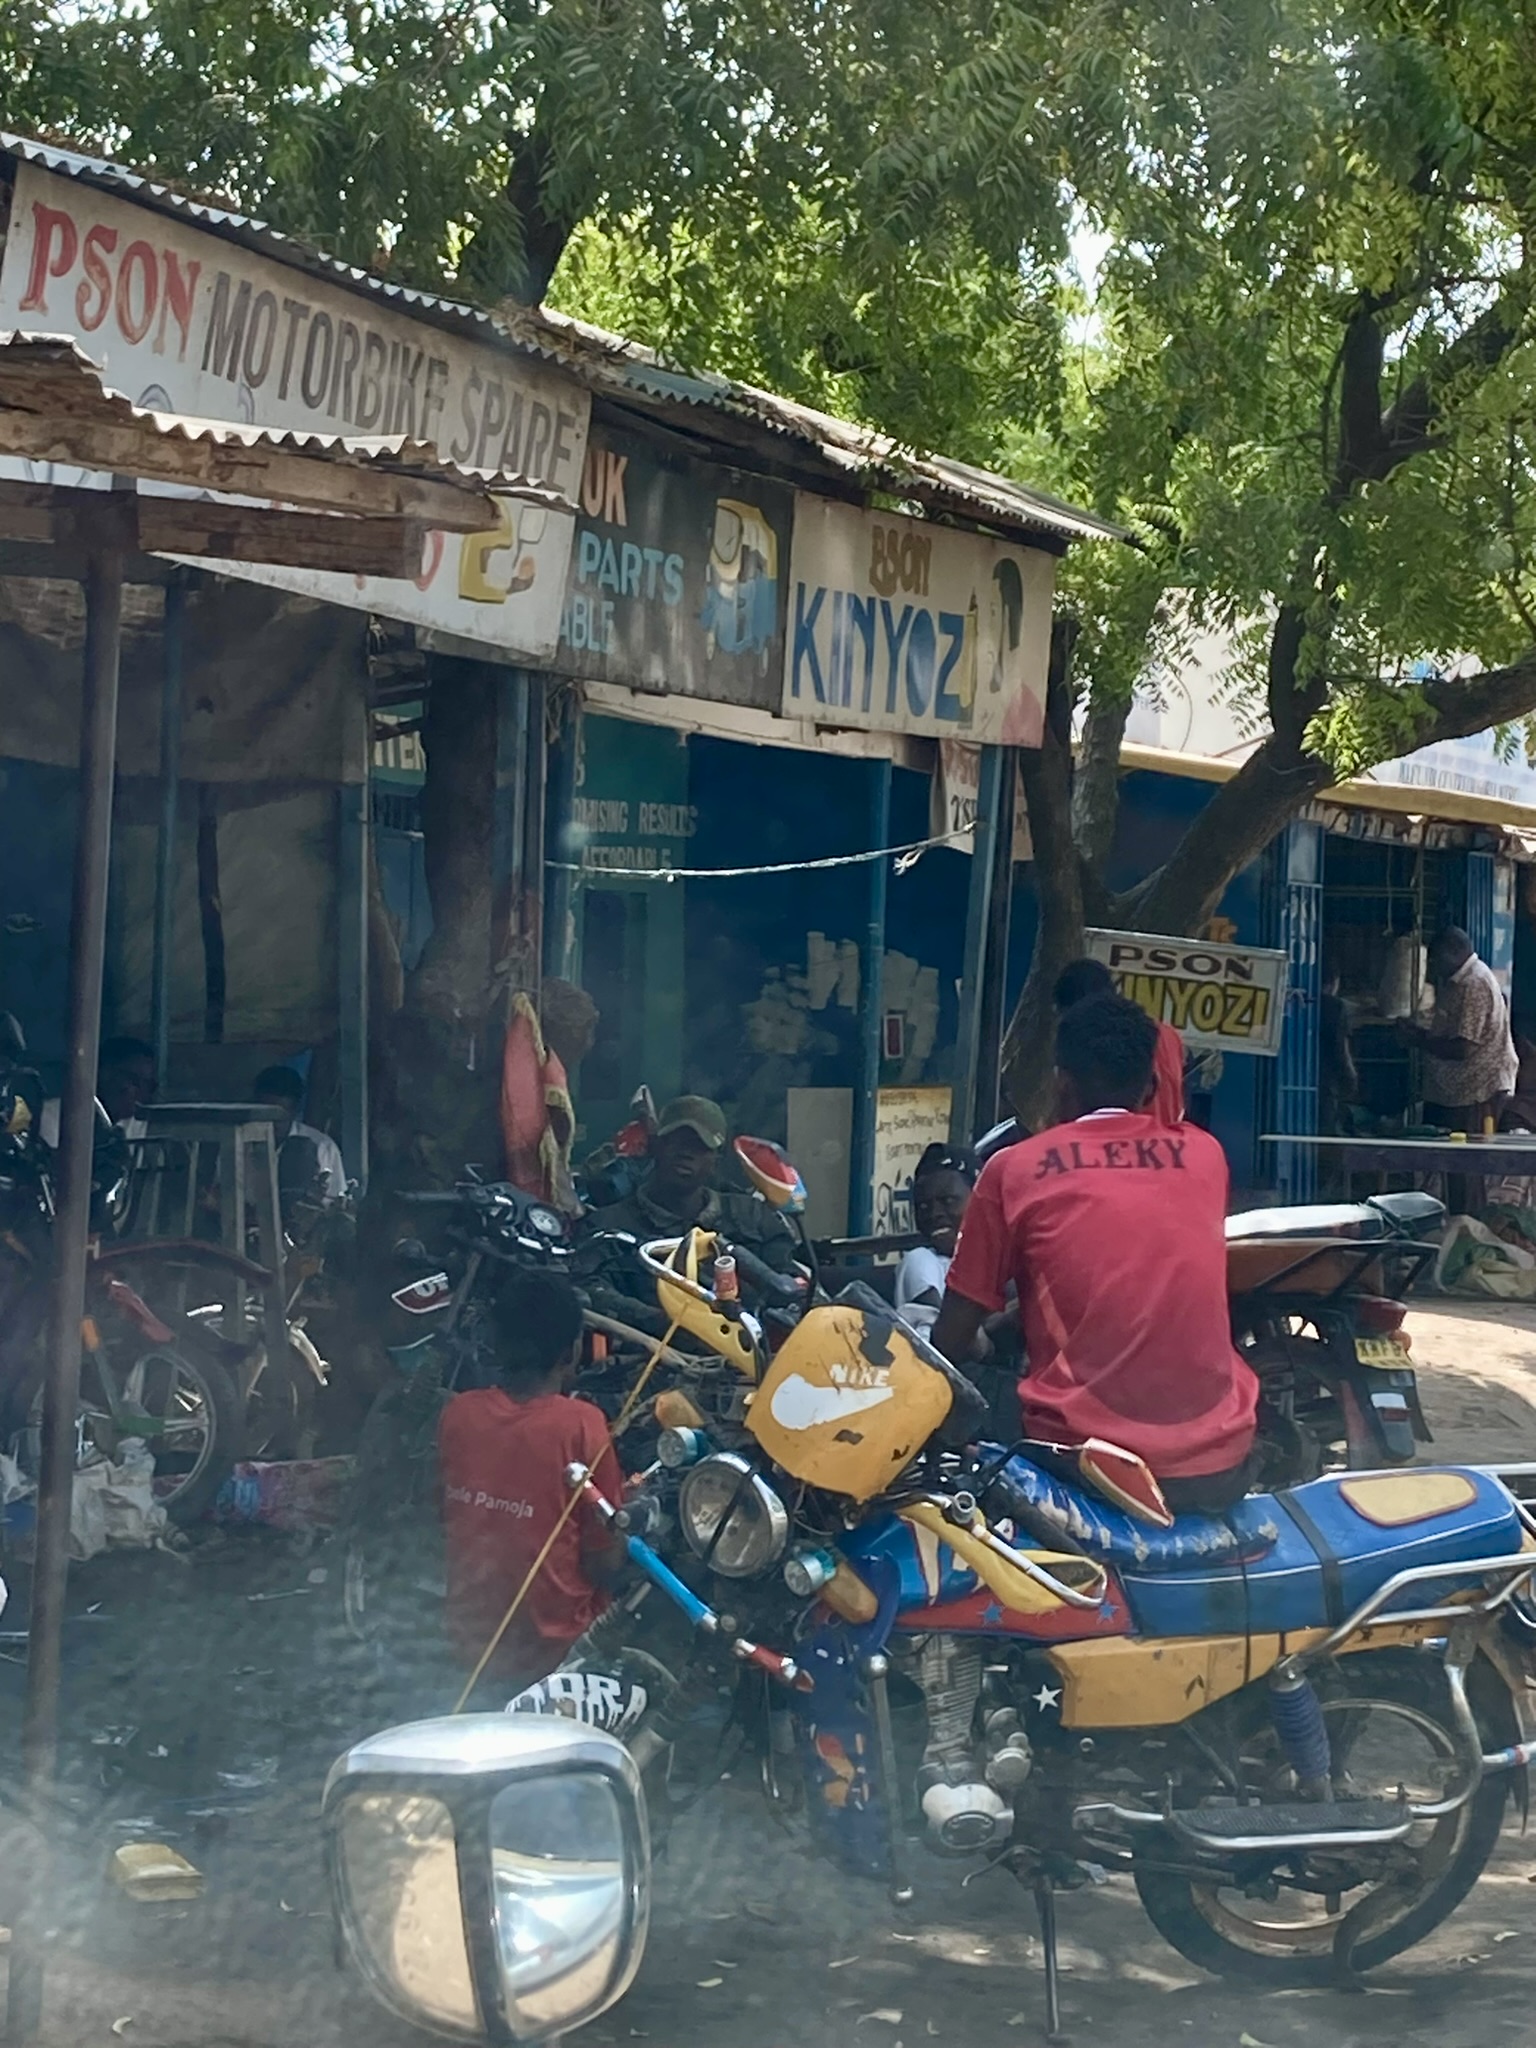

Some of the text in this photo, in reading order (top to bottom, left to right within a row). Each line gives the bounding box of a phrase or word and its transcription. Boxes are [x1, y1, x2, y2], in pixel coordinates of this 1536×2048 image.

[18, 200, 577, 493] PSON MOTORBIKE SPARE
[578, 530, 684, 606] PARTS
[1109, 943, 1254, 981] PSON
[1034, 1138, 1186, 1180] ALEKY
[829, 1363, 890, 1386] NIKE
[474, 1491, 534, 1519] Pamoja
